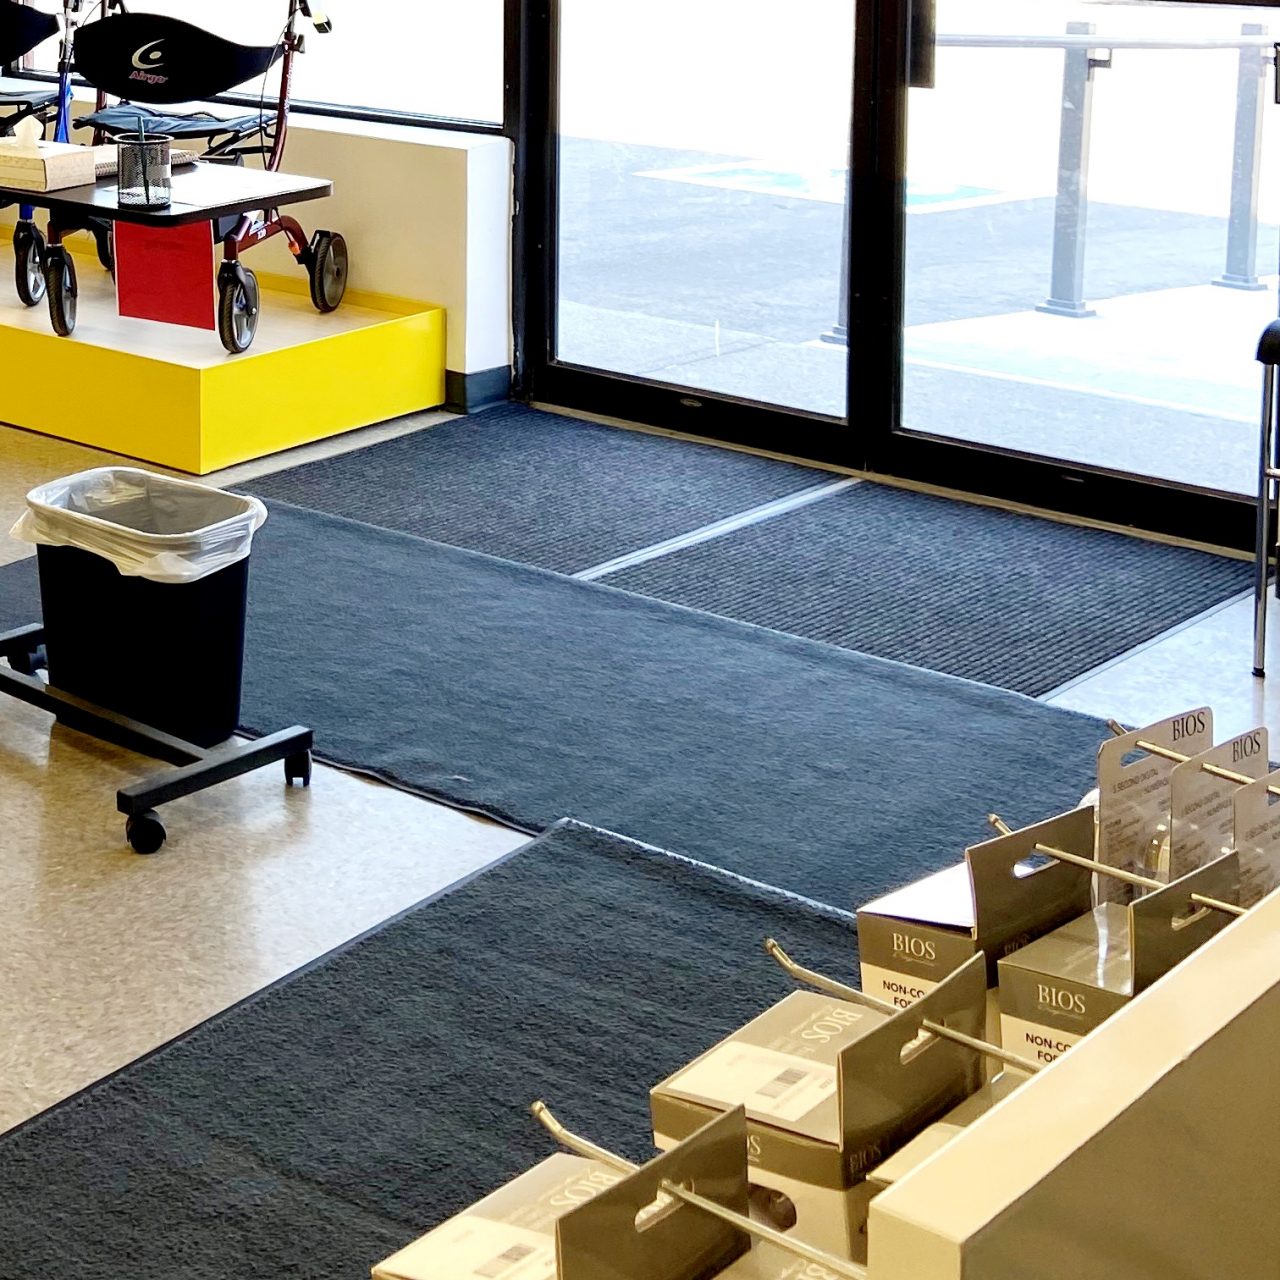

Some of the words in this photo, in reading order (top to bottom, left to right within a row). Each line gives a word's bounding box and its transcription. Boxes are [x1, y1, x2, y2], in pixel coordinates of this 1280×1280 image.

[128, 70, 169, 84] Airgo
[1172, 711, 1206, 742] BIOS
[1232, 731, 1261, 763] BIOS
[892, 932, 936, 961] BIOS
[1037, 984, 1087, 1015] BIOS
[800, 1007, 865, 1044] BIOS
